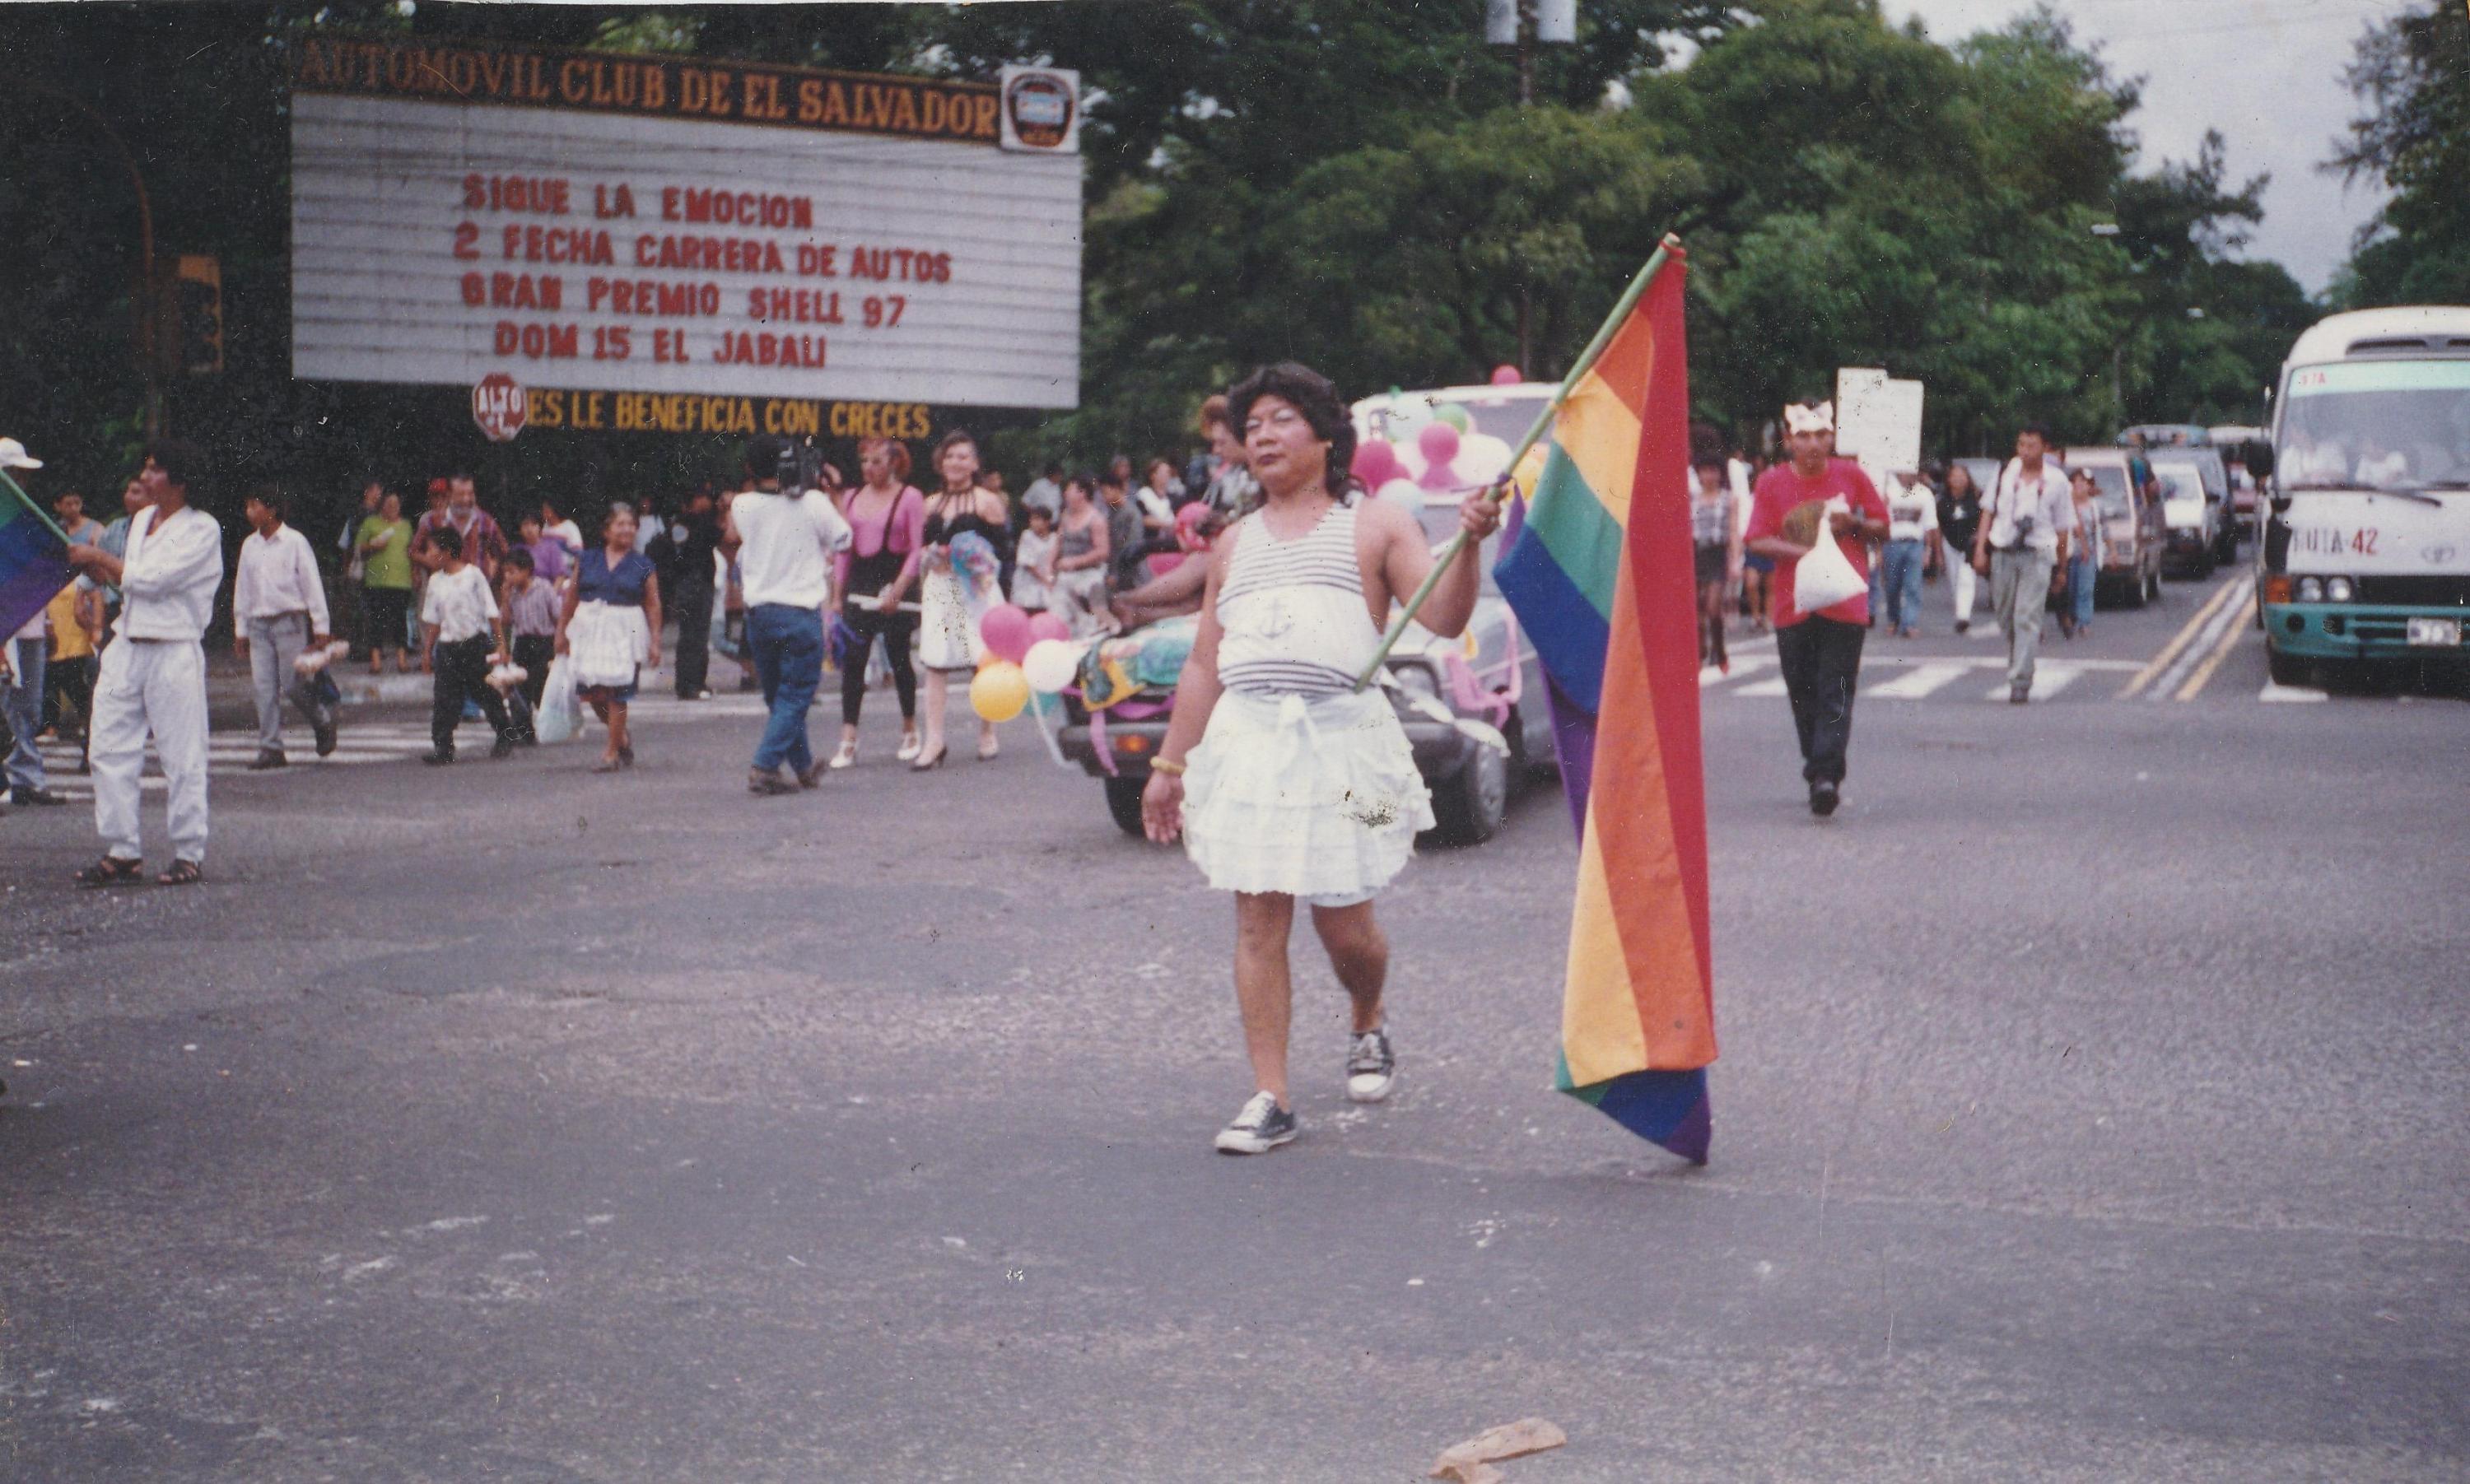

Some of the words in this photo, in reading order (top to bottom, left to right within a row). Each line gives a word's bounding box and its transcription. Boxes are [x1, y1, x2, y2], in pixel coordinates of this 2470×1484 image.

[300, 39, 550, 100] AUTOMOVIL
[561, 58, 666, 110] CLUB
[681, 67, 731, 115] DE
[743, 72, 787, 119] EL
[798, 78, 998, 137] SALVADOR
[463, 173, 570, 215] SIGUE
[594, 182, 635, 219] LA
[661, 185, 813, 230] EMOCION
[454, 220, 481, 262] 2
[503, 222, 614, 266] FECHA
[635, 233, 784, 273] CARRERA
[798, 243, 837, 277] DE
[850, 245, 952, 284] AUTOS
[460, 271, 562, 311] GRAN
[587, 277, 720, 317] PREMIO
[748, 287, 844, 325] SHELL
[863, 295, 905, 328] 97
[496, 320, 578, 361] DOM
[593, 325, 631, 361] 15
[654, 327, 689, 365] EL
[478, 385, 523, 415] ALTO
[571, 390, 605, 428] LE
[616, 391, 756, 435] BENEFICIA
[763, 398, 819, 435] CON
[829, 402, 931, 440] CRECES
